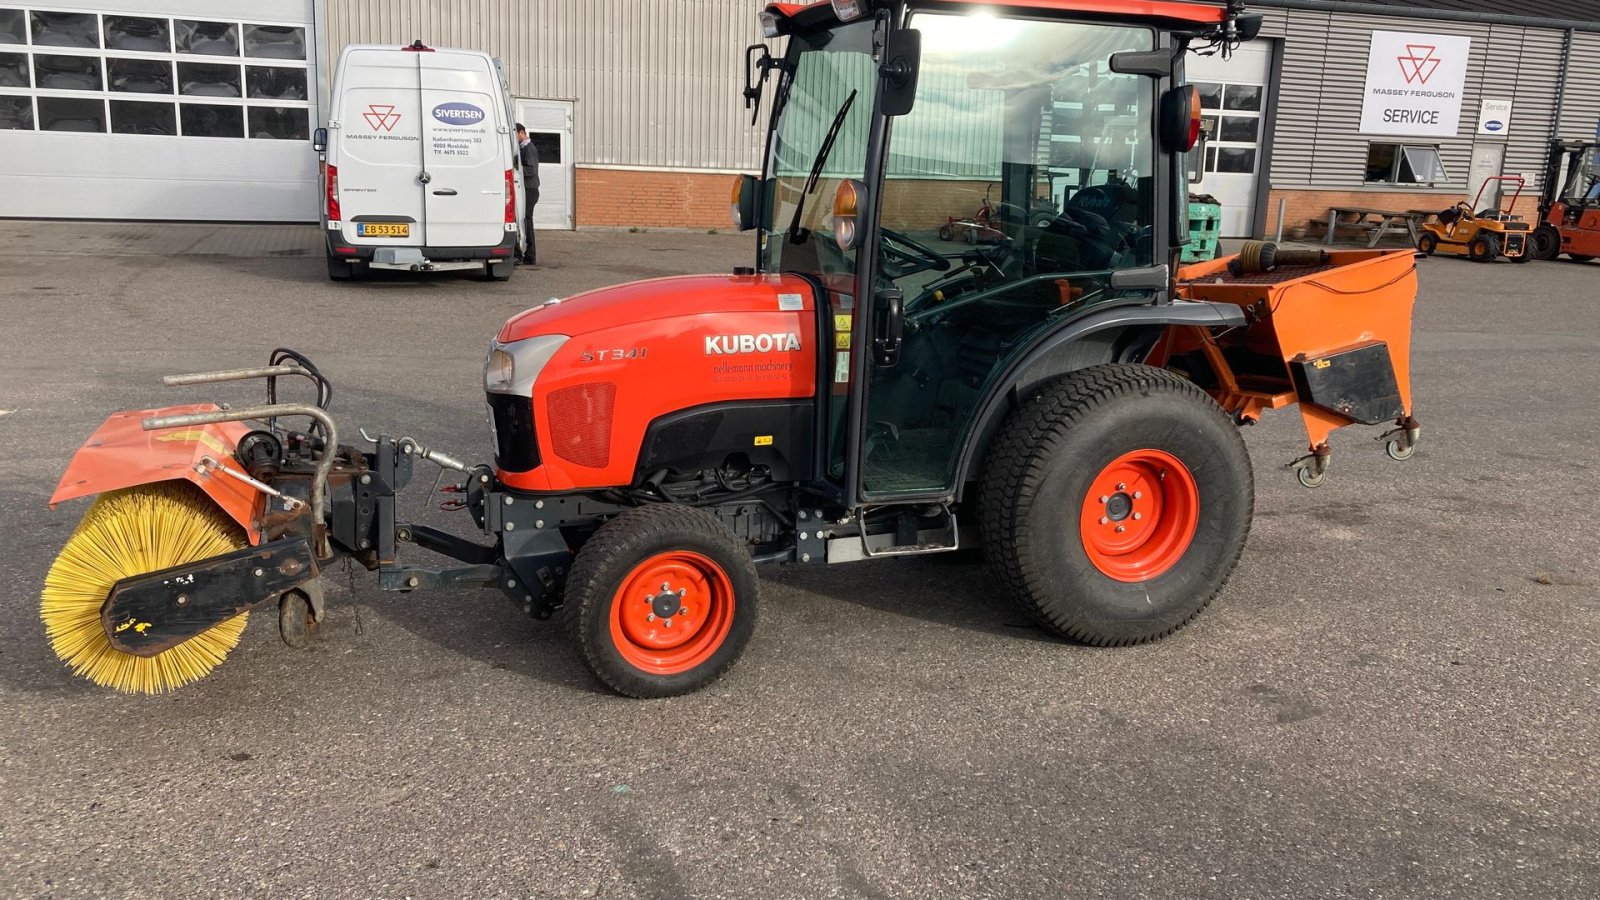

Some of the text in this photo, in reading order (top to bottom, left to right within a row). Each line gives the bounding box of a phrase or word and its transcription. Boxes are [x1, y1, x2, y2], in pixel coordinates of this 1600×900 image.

[1372, 88, 1455, 98] MASSEY FERGUSON
[1485, 102, 1508, 111] Service
[435, 108, 482, 119] SIVERTSEN
[1383, 108, 1439, 124] SERVICE
[364, 225, 407, 234] EB 53 514
[705, 332, 800, 355] KUBOTA
[754, 359, 793, 372] machinery
